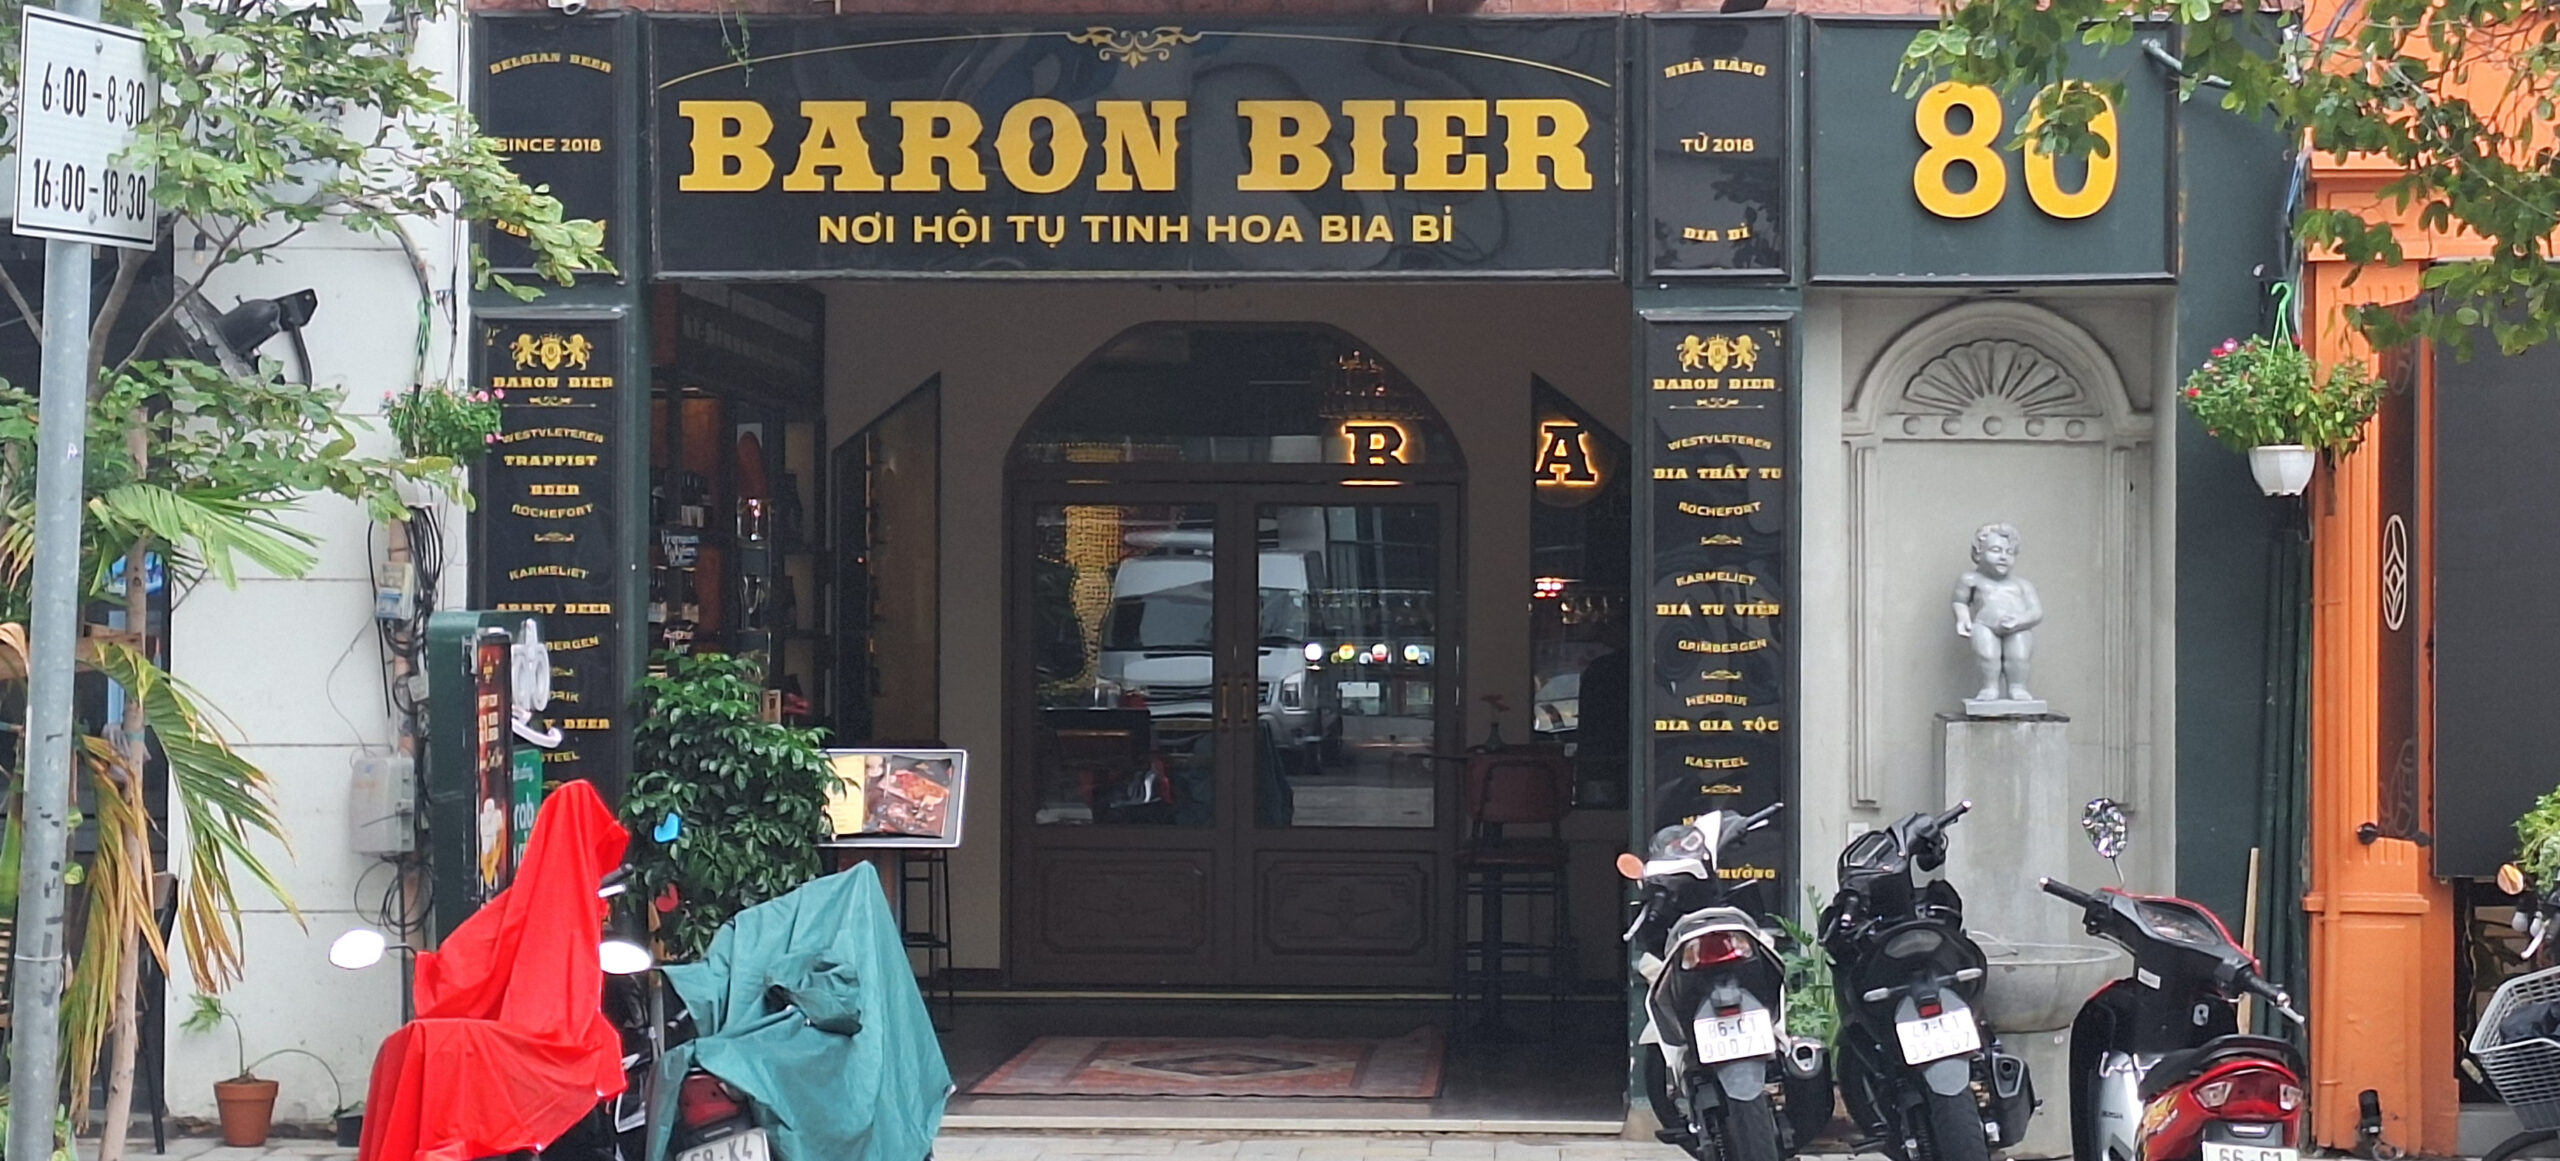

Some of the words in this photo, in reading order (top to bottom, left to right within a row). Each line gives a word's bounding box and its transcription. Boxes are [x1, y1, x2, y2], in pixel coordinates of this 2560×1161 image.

[489, 53, 560, 74] BELGIAN
[570, 54, 612, 73] BEER
[1664, 57, 1705, 78] NHÀ
[1713, 57, 1767, 77] HÀNG
[497, 138, 556, 152] SINCE
[561, 138, 602, 152] 2018
[678, 98, 1187, 193] BARON
[1236, 99, 1593, 191] BIER
[1680, 131, 1709, 153] TỪ
[1713, 138, 1754, 153] 2018
[1914, 80, 2118, 219] 80
[819, 211, 895, 244] NƠI
[913, 208, 990, 248] HỘI
[1007, 215, 1065, 248] TỤ
[1081, 215, 1189, 243] TINH
[1207, 214, 1304, 243] HOA
[1321, 214, 1394, 243] BIA
[1412, 205, 1452, 243] BỈ
[493, 376, 559, 389] BARON
[568, 376, 613, 389] BIER
[1653, 378, 1719, 390] BARON
[1729, 378, 1775, 390] BIER
[501, 427, 604, 444] WESTVLETEREN
[1667, 434, 1772, 450] WESTVLETEREN
[504, 455, 598, 467] TRAPPIST
[1653, 467, 1689, 479] BIA
[1759, 467, 1782, 479] TU
[530, 484, 580, 496] BEER
[511, 503, 593, 519] ROCHEFORT
[1678, 501, 1761, 517] ROCHEFORT
[509, 565, 588, 581] KARMELIET
[1675, 571, 1757, 587] KARMELIET
[565, 603, 611, 614] BEER
[1656, 603, 1691, 616] BIA
[1700, 603, 1725, 616] TU
[1678, 639, 1767, 653] GRIMBERGEN
[564, 718, 610, 730] BEER
[1655, 719, 1690, 731] BIA
[1699, 719, 1734, 731] GIA
[1684, 756, 1749, 769] KASTEEL
